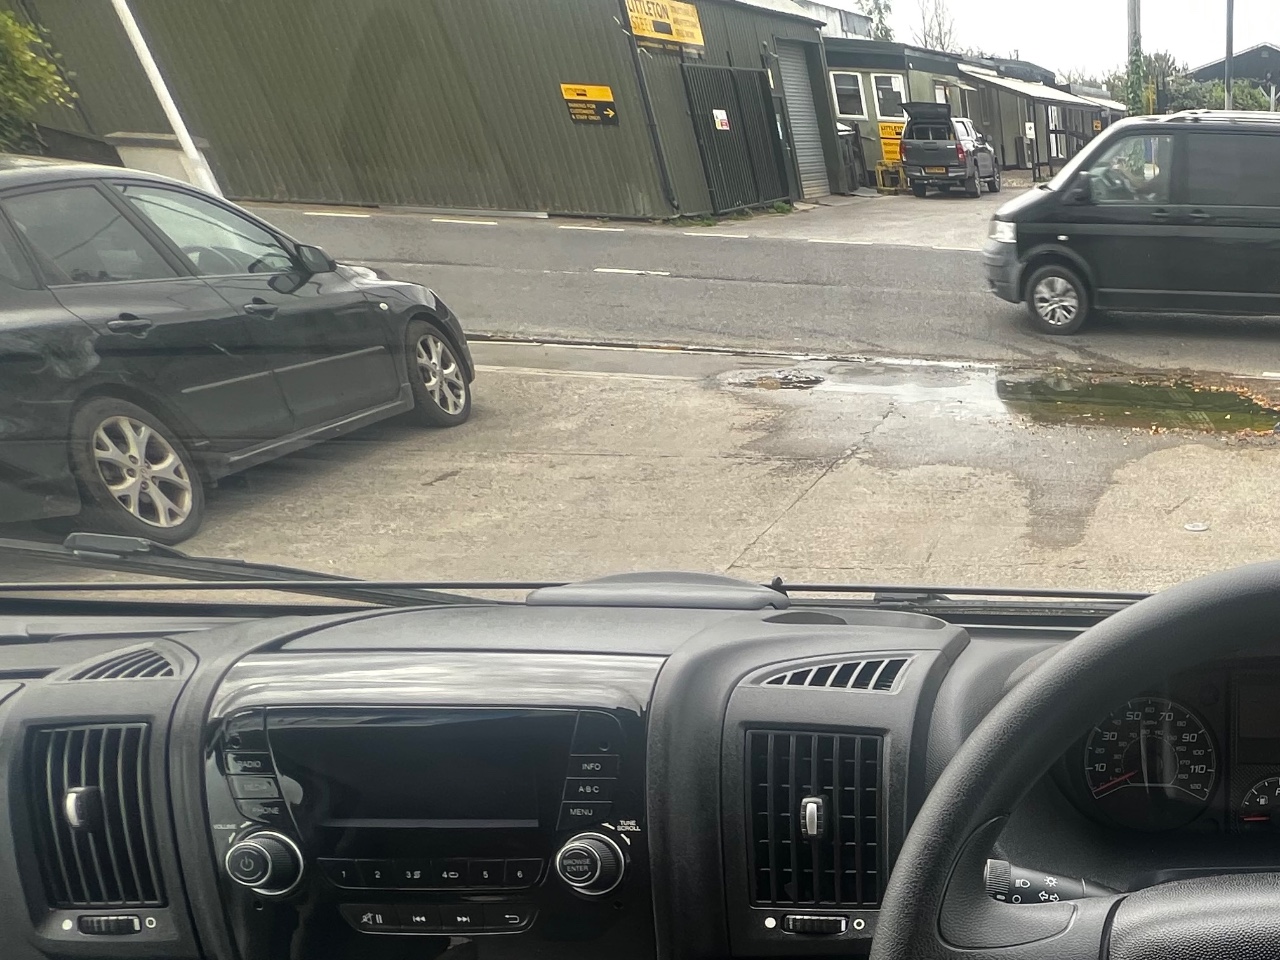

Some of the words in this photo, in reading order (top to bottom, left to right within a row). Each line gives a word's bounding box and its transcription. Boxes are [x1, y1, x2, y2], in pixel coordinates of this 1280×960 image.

[626, 0, 669, 19] LITTLETON
[1126, 711, 1142, 720] 50
[1158, 712, 1174, 721] 70
[1102, 731, 1118, 741] 30
[1182, 733, 1197, 742] 90
[1094, 763, 1106, 772] 10
[1190, 765, 1206, 773] 110
[252, 807, 279, 815] PHONE
[570, 808, 593, 816] MENU
